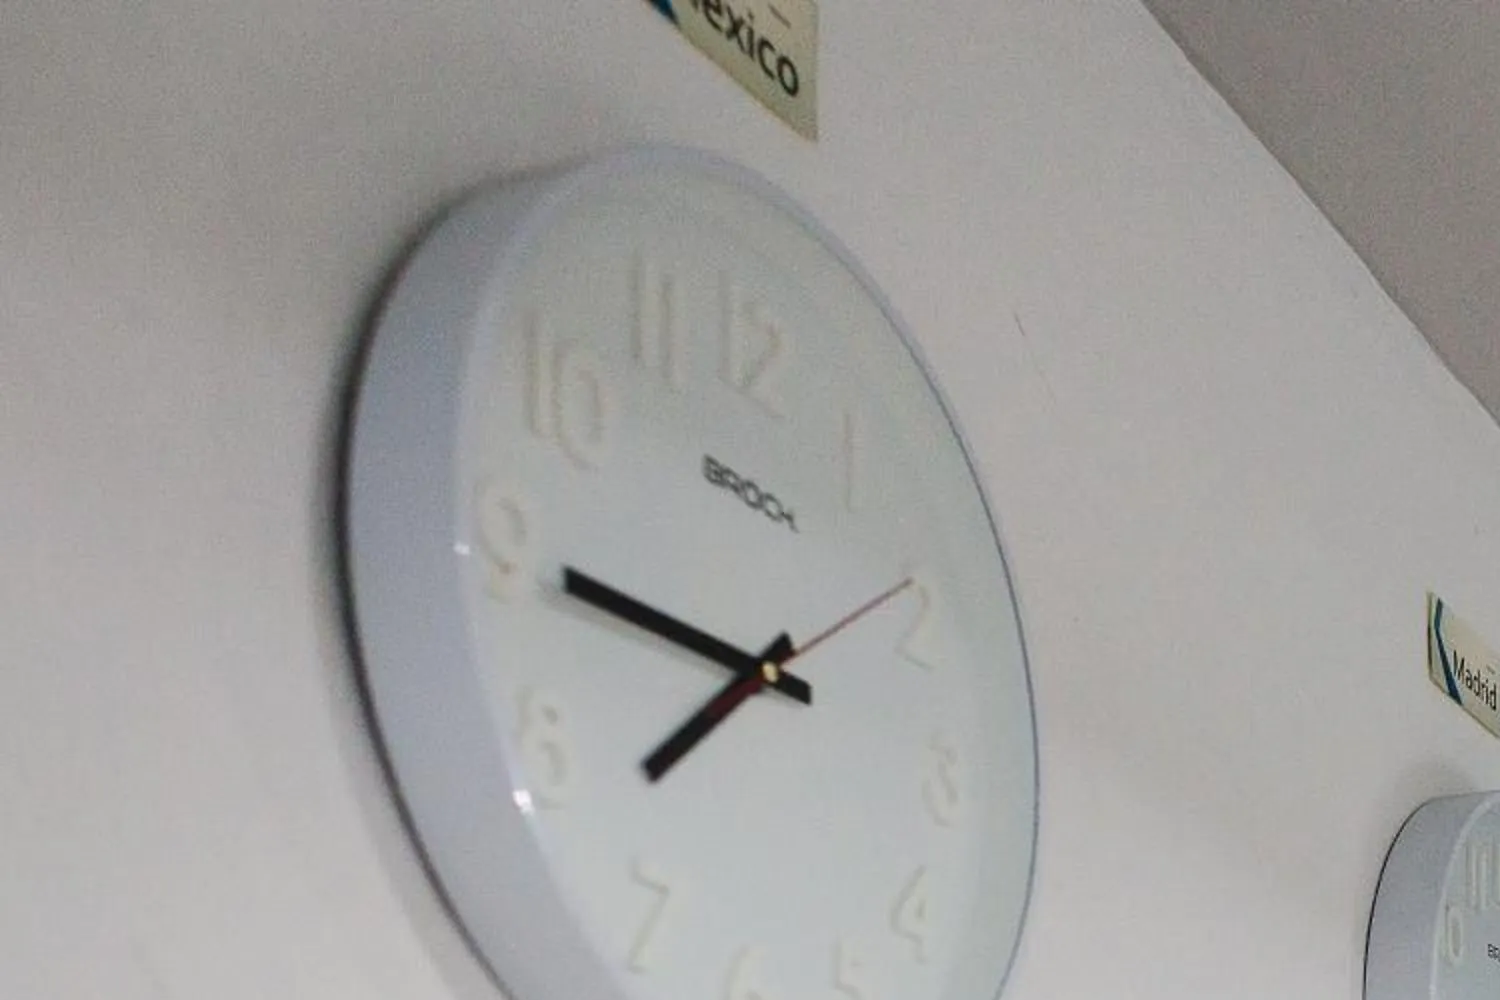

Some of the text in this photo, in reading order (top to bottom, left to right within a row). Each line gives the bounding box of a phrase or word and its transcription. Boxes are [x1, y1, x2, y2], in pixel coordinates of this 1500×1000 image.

[691, 0, 799, 97] exico
[630, 246, 686, 396] 11
[716, 266, 788, 424] 12
[523, 306, 612, 475] 10
[1452, 649, 1498, 711] Madrid
[627, 852, 678, 977] 7
[888, 860, 932, 966] 4
